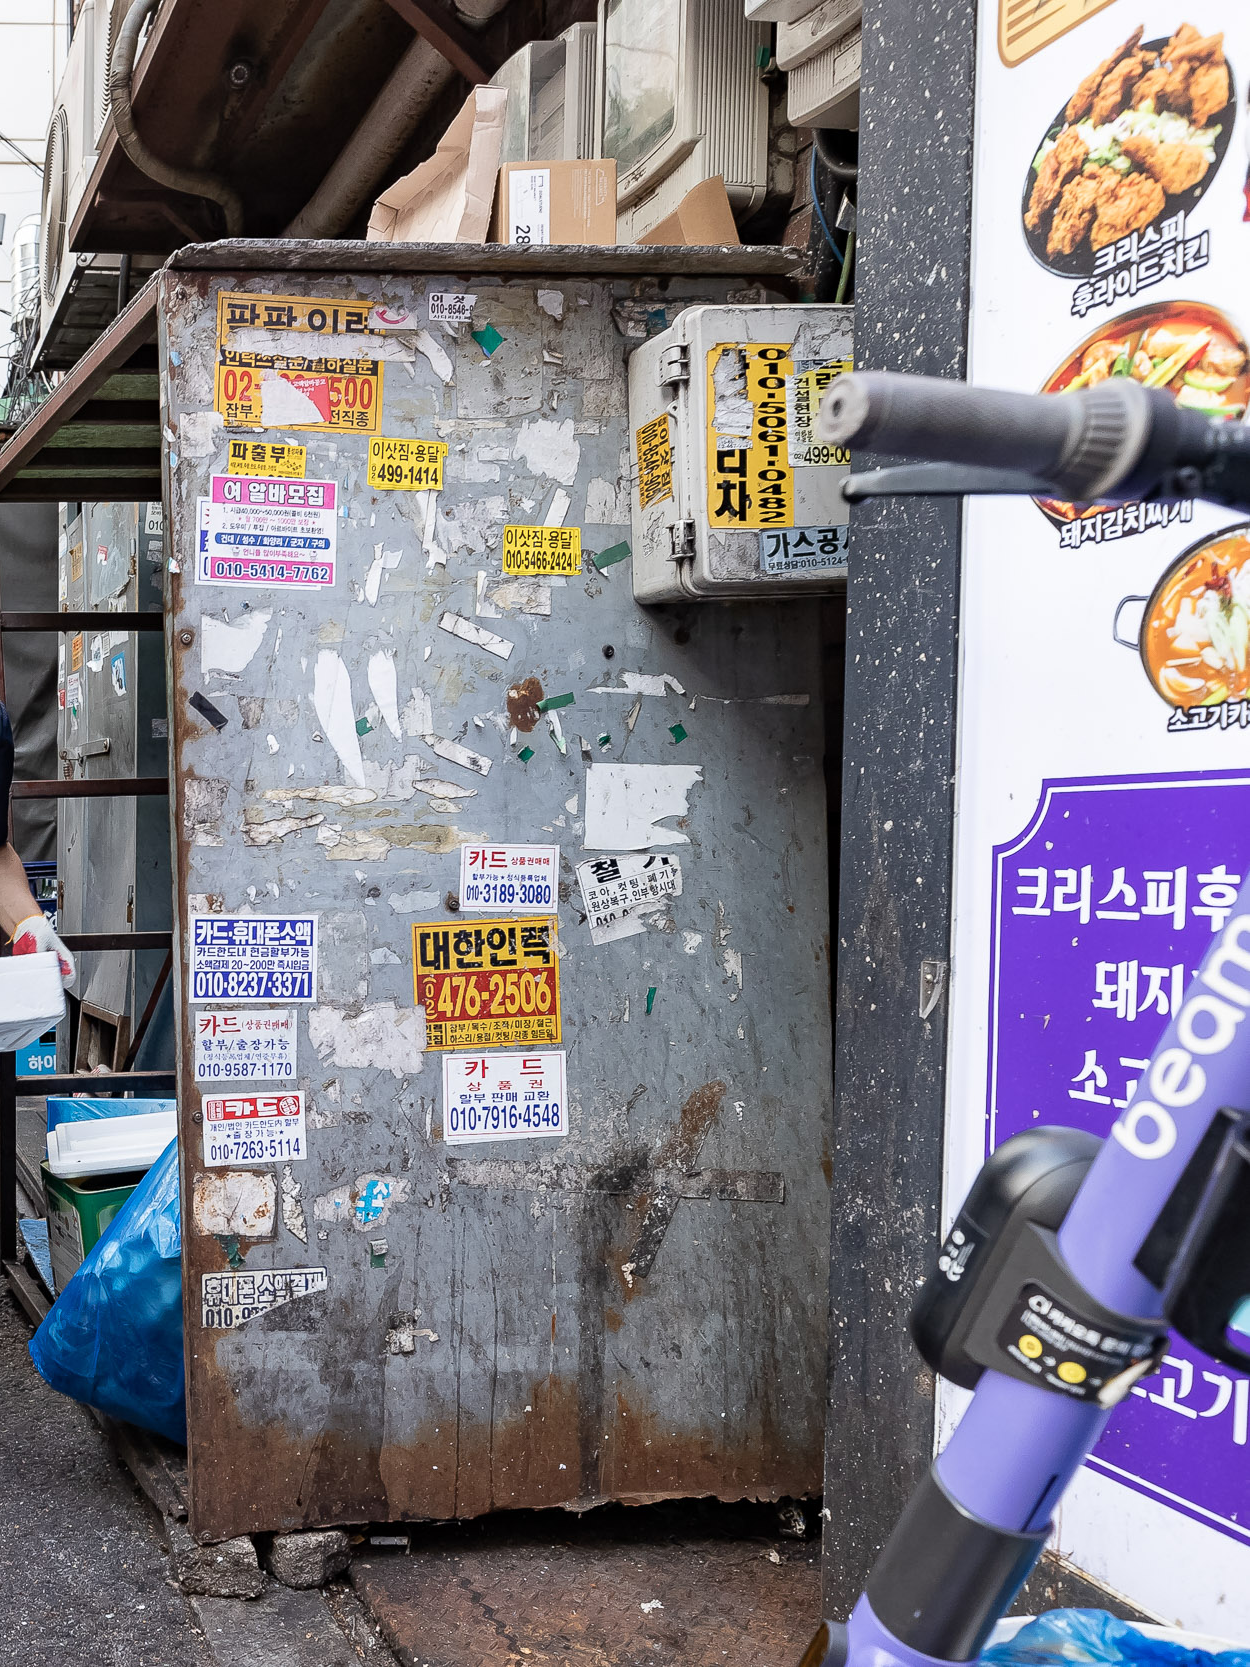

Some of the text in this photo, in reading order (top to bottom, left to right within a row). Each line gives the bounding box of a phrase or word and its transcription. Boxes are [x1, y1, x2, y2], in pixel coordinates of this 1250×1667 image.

[1092, 209, 1185, 276] 크리스피
[1071, 229, 1210, 318] 후라이드치킨
[231, 443, 285, 463] 파출부
[224, 481, 325, 507] 여 알바모집
[216, 562, 328, 580] 010-5414-7762
[1168, 700, 1250, 732] 소고기카
[469, 850, 550, 869] 카드 상품권매매
[196, 947, 310, 958] 카드한도내 현금할부가능
[419, 925, 551, 970] 대한인력
[196, 959, 310, 971] 소액결제 20~200만 즉시입금
[1092, 960, 1199, 1021] 돼지
[199, 1015, 241, 1037] 카드
[1112, 913, 1250, 1160] beam
[225, 1099, 278, 1117] 카드
[459, 1090, 550, 1104] 할부 판매 교환
[205, 1276, 255, 1307] 휴대폰
[1130, 1355, 1250, 1445] 고기
